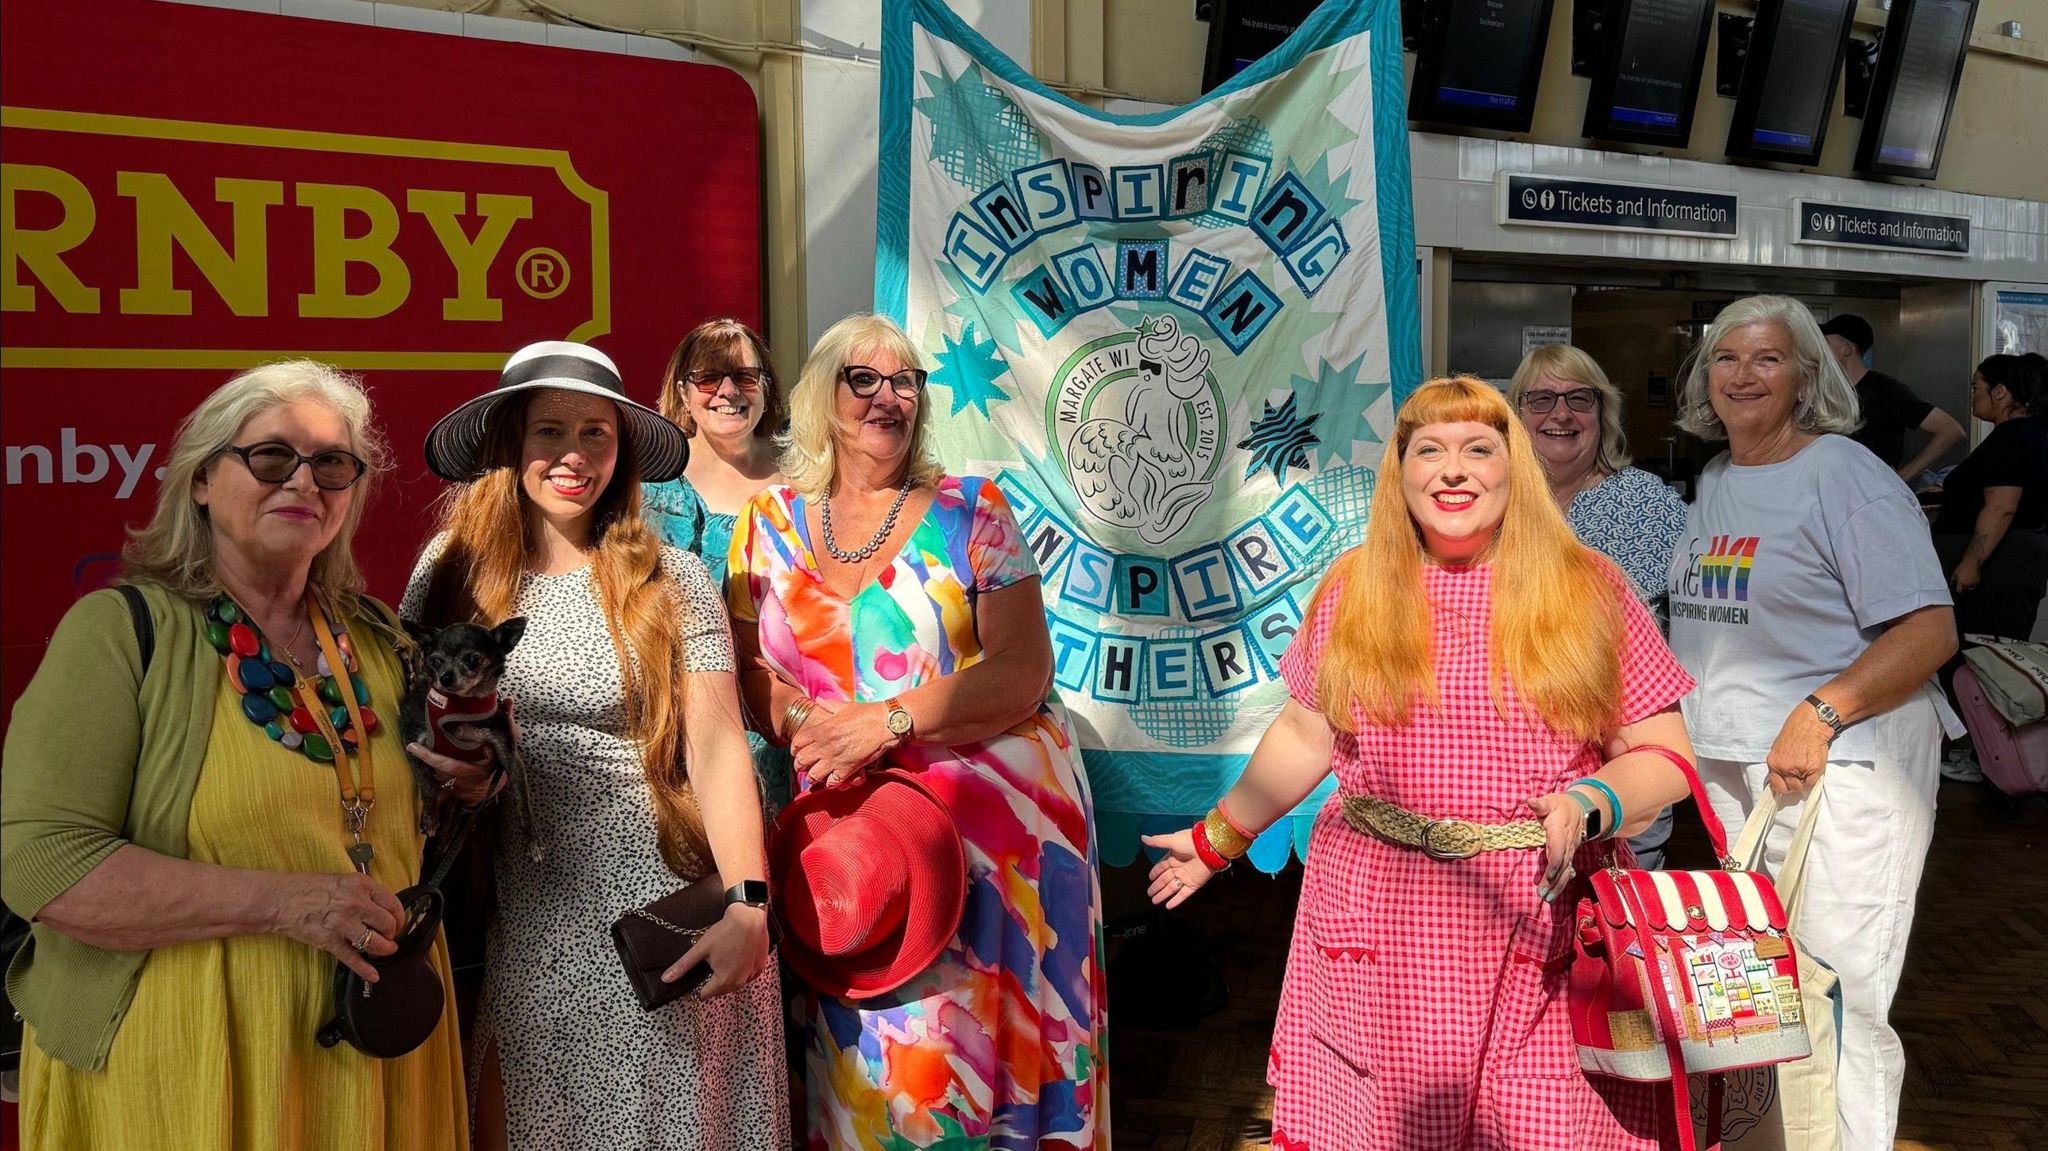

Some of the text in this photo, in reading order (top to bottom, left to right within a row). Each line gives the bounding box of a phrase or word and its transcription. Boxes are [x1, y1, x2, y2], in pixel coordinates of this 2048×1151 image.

[1558, 190, 1727, 223] Tickets and Information
[1837, 214, 1962, 243] Tickets and Information
[1021, 249, 1267, 336] WOMEN
[1059, 348, 1130, 424] MARGATE WI
[1195, 400, 1214, 461] EST. 2015
[1671, 602, 1749, 625] INSPIRING WOMEN
[1055, 612, 1297, 692] THERS
[1753, 1080, 1765, 1103] 2015
